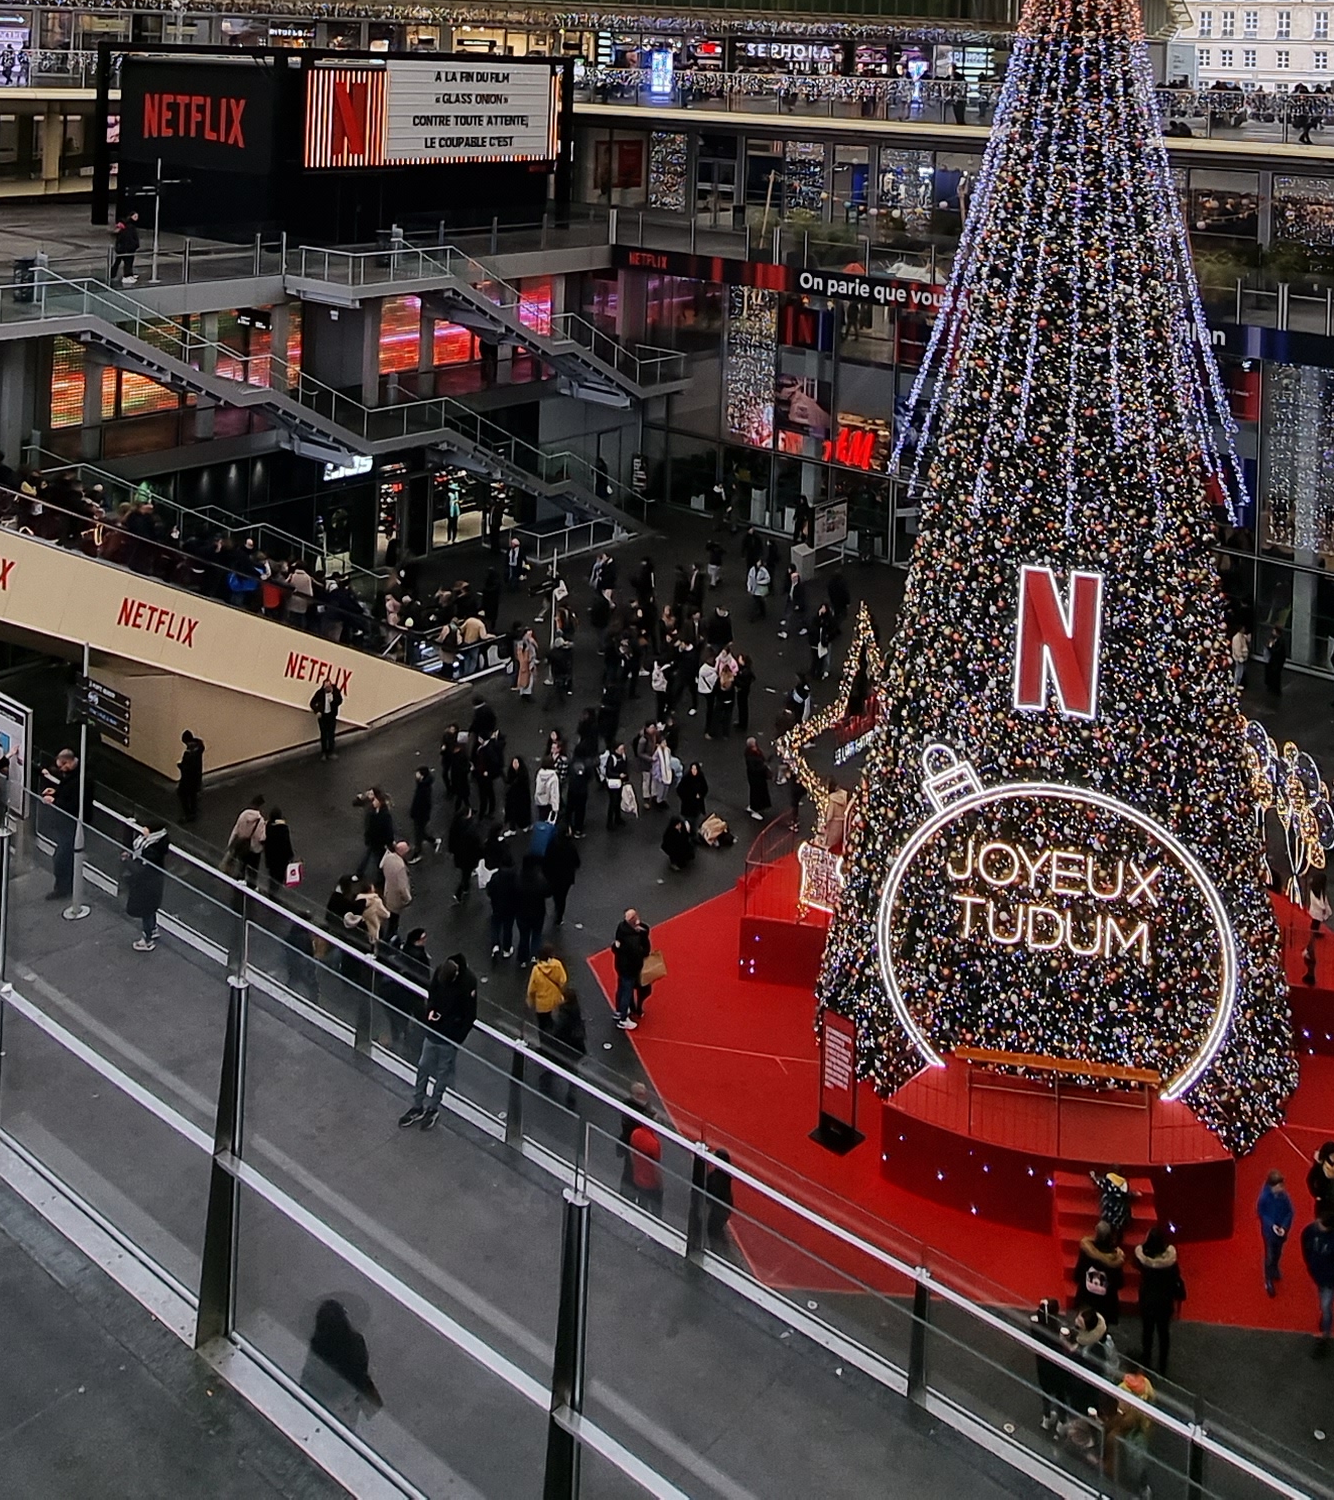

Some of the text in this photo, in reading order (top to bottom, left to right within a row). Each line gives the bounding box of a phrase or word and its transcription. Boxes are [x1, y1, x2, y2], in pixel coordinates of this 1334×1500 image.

[747, 43, 831, 59] SEPHORA
[445, 71, 457, 82] LA
[460, 71, 474, 82] FIN
[476, 72, 488, 82] DU
[490, 72, 509, 83] FILM
[143, 93, 246, 148] NETFLIX
[413, 115, 451, 126] CONTRE
[454, 115, 484, 126] TOUTE
[424, 136, 514, 148] LE COUPABLE C'EST
[629, 252, 667, 269] NETFLIX
[800, 272, 951, 308] On parie que vou
[116, 597, 199, 648] NETFLIX
[1014, 565, 1102, 720] N
[947, 840, 1161, 908] JOYEUX
[952, 894, 1149, 966] TUDUM
